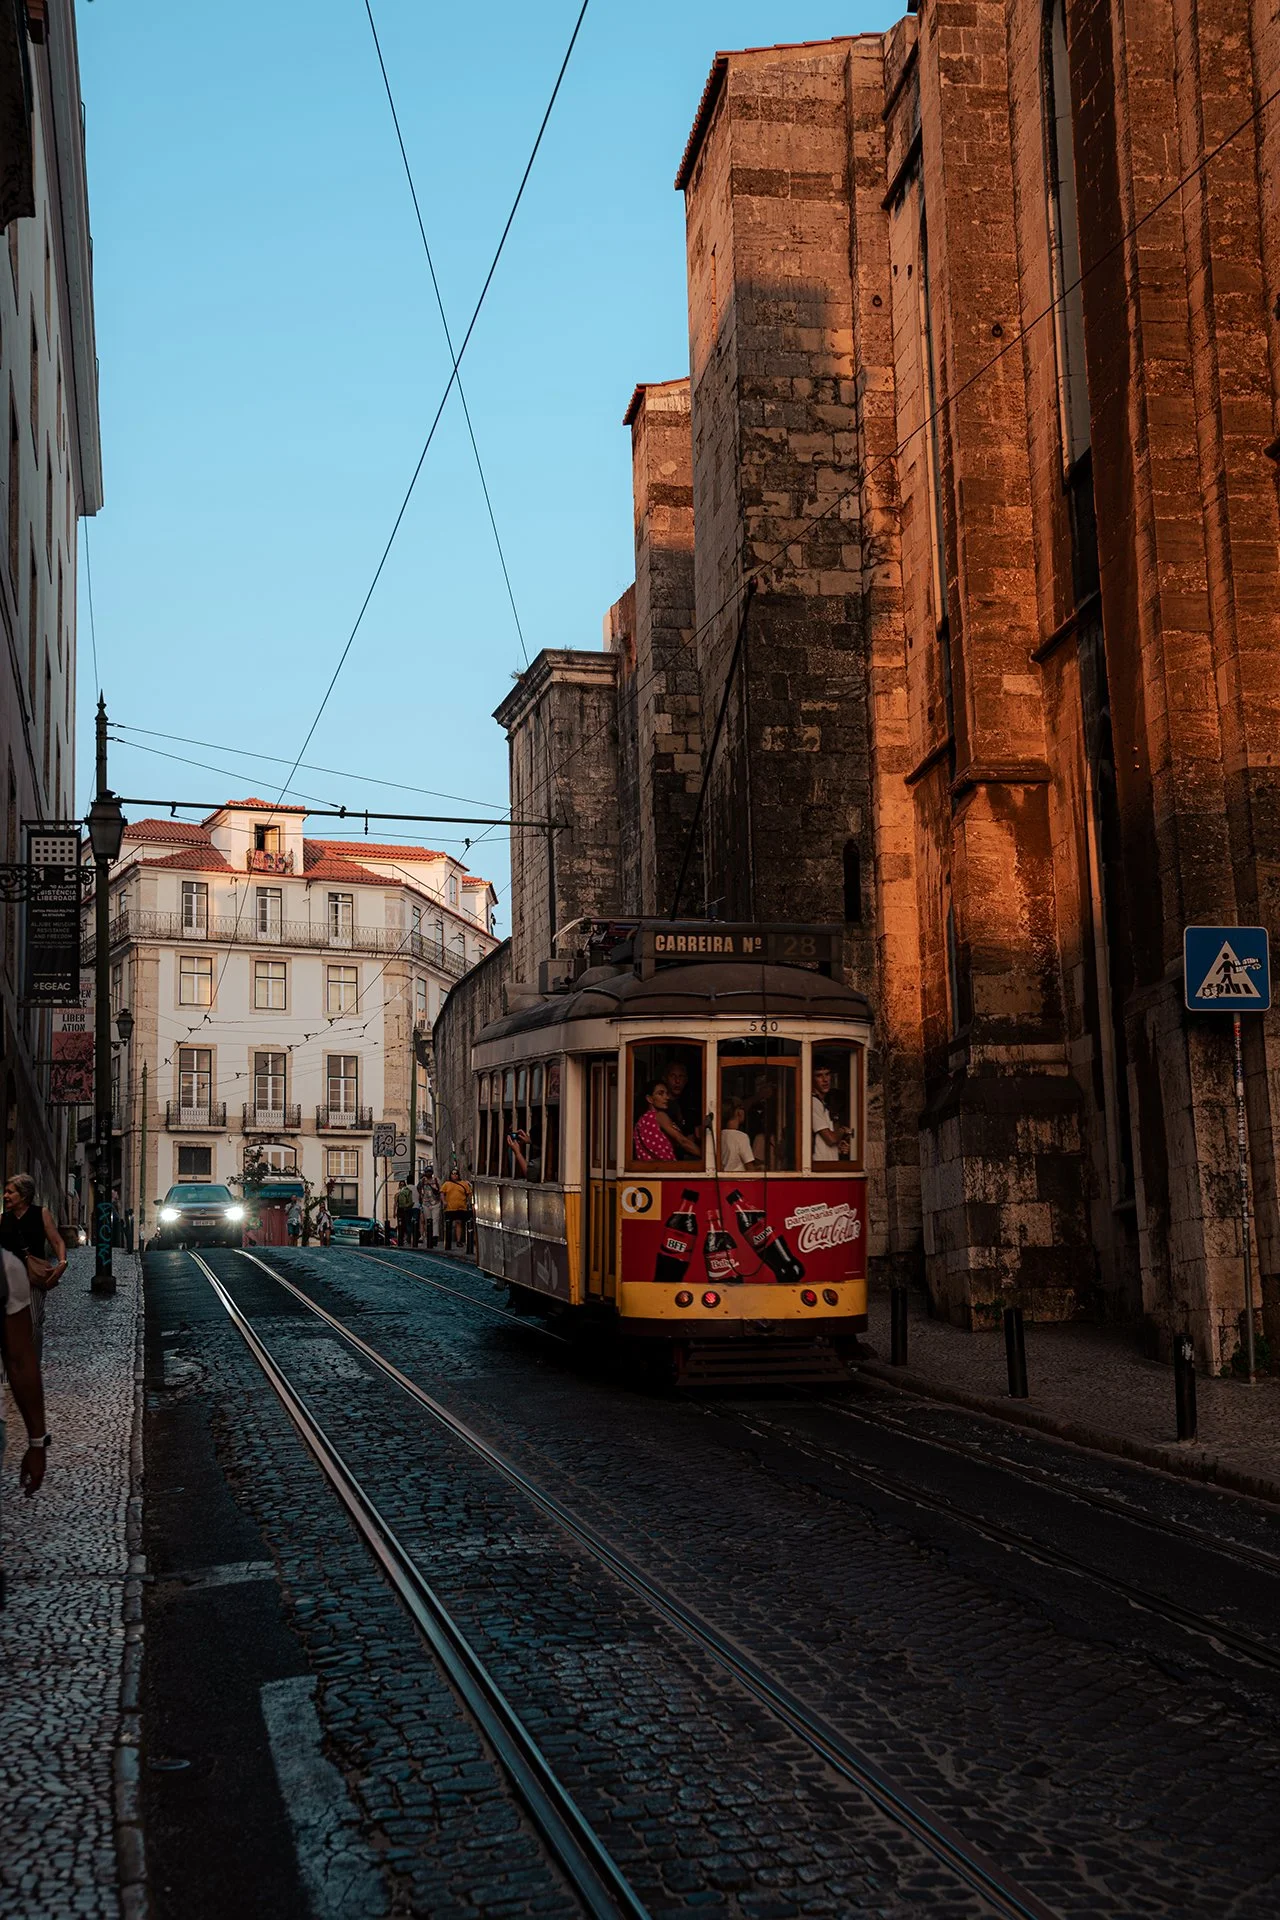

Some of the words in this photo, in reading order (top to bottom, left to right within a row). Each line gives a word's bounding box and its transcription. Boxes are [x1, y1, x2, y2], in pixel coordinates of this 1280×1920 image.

[655, 934, 735, 953] CARREIRA
[783, 936, 818, 956] 28
[39, 982, 71, 991] EGEAC
[62, 1013, 86, 1023] LIBER
[62, 1023, 86, 1033] ATION
[750, 1020, 779, 1033] 560
[668, 1238, 687, 1252] BFF
